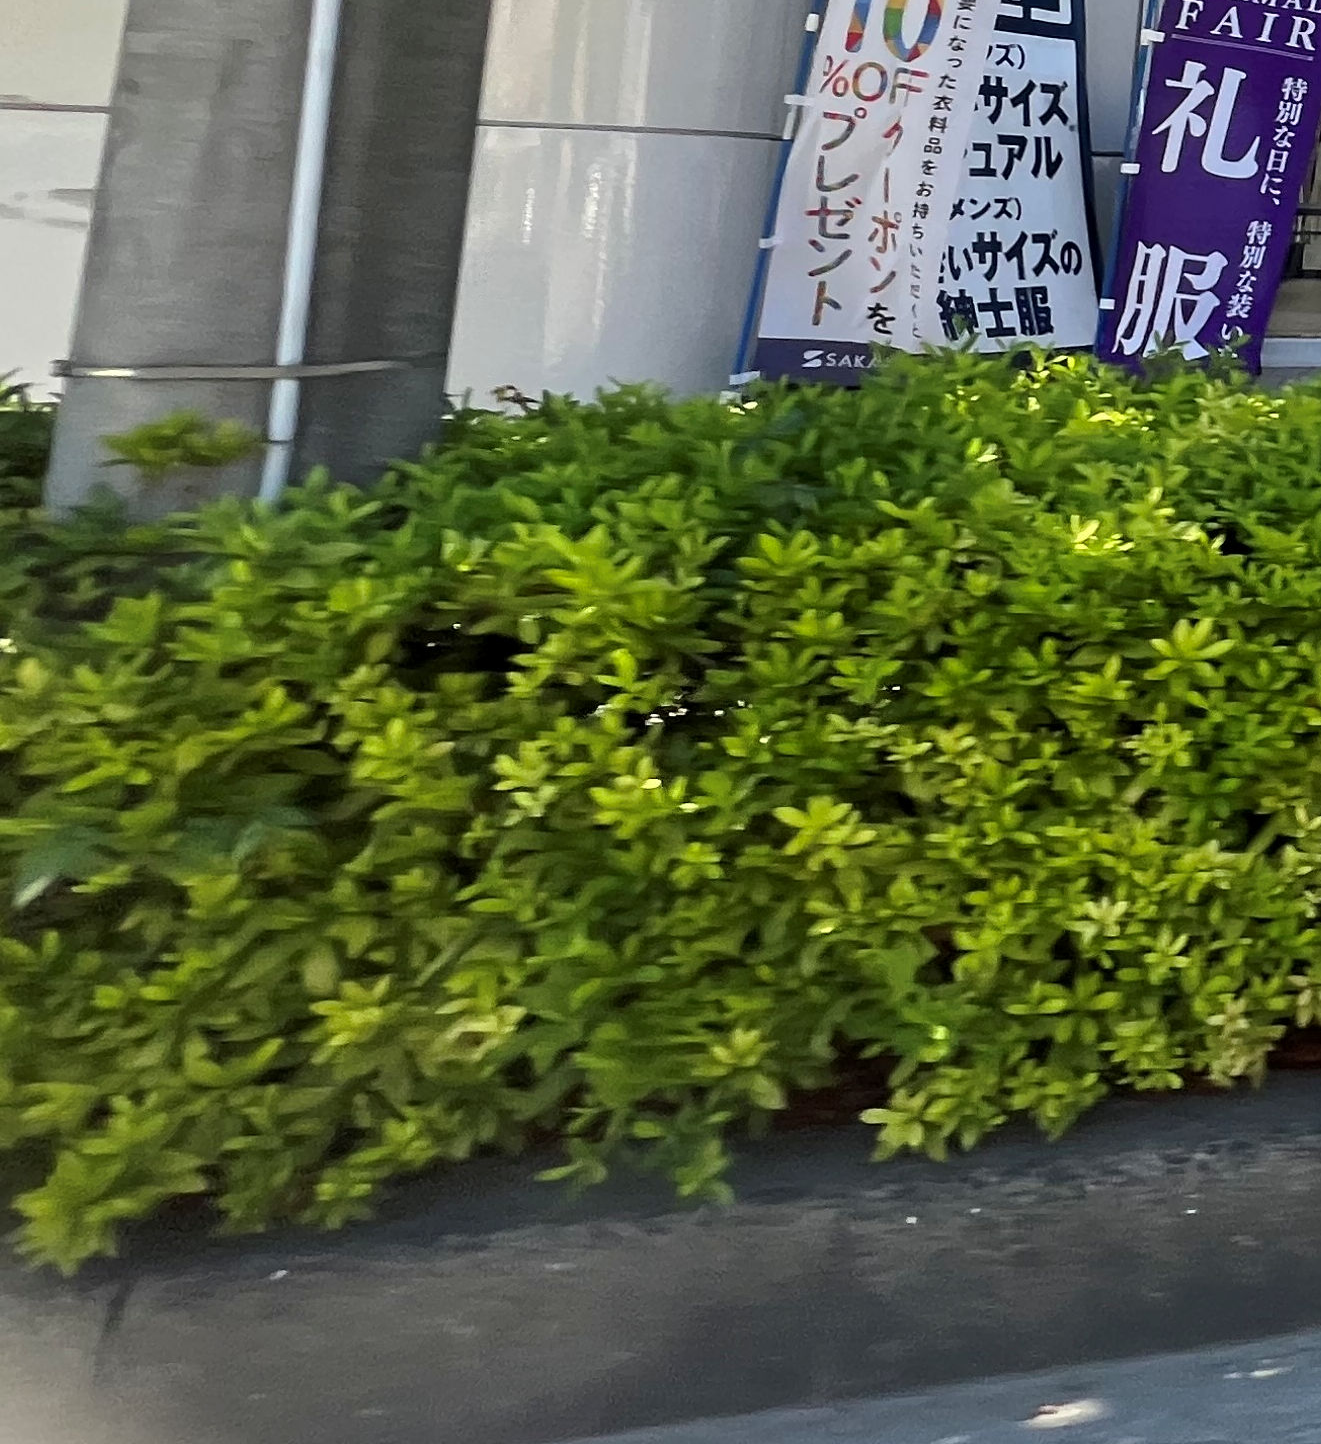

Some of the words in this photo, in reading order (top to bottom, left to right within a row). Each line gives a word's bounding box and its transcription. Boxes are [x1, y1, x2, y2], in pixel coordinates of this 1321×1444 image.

[974, 74, 1070, 127] サイズ
[985, 43, 1027, 70] ズ)
[963, 133, 1064, 180] ュアル
[1260, 76, 1309, 206] 特別な日に、
[804, 107, 868, 326] プレゼント
[1111, 59, 1261, 361] 礼服
